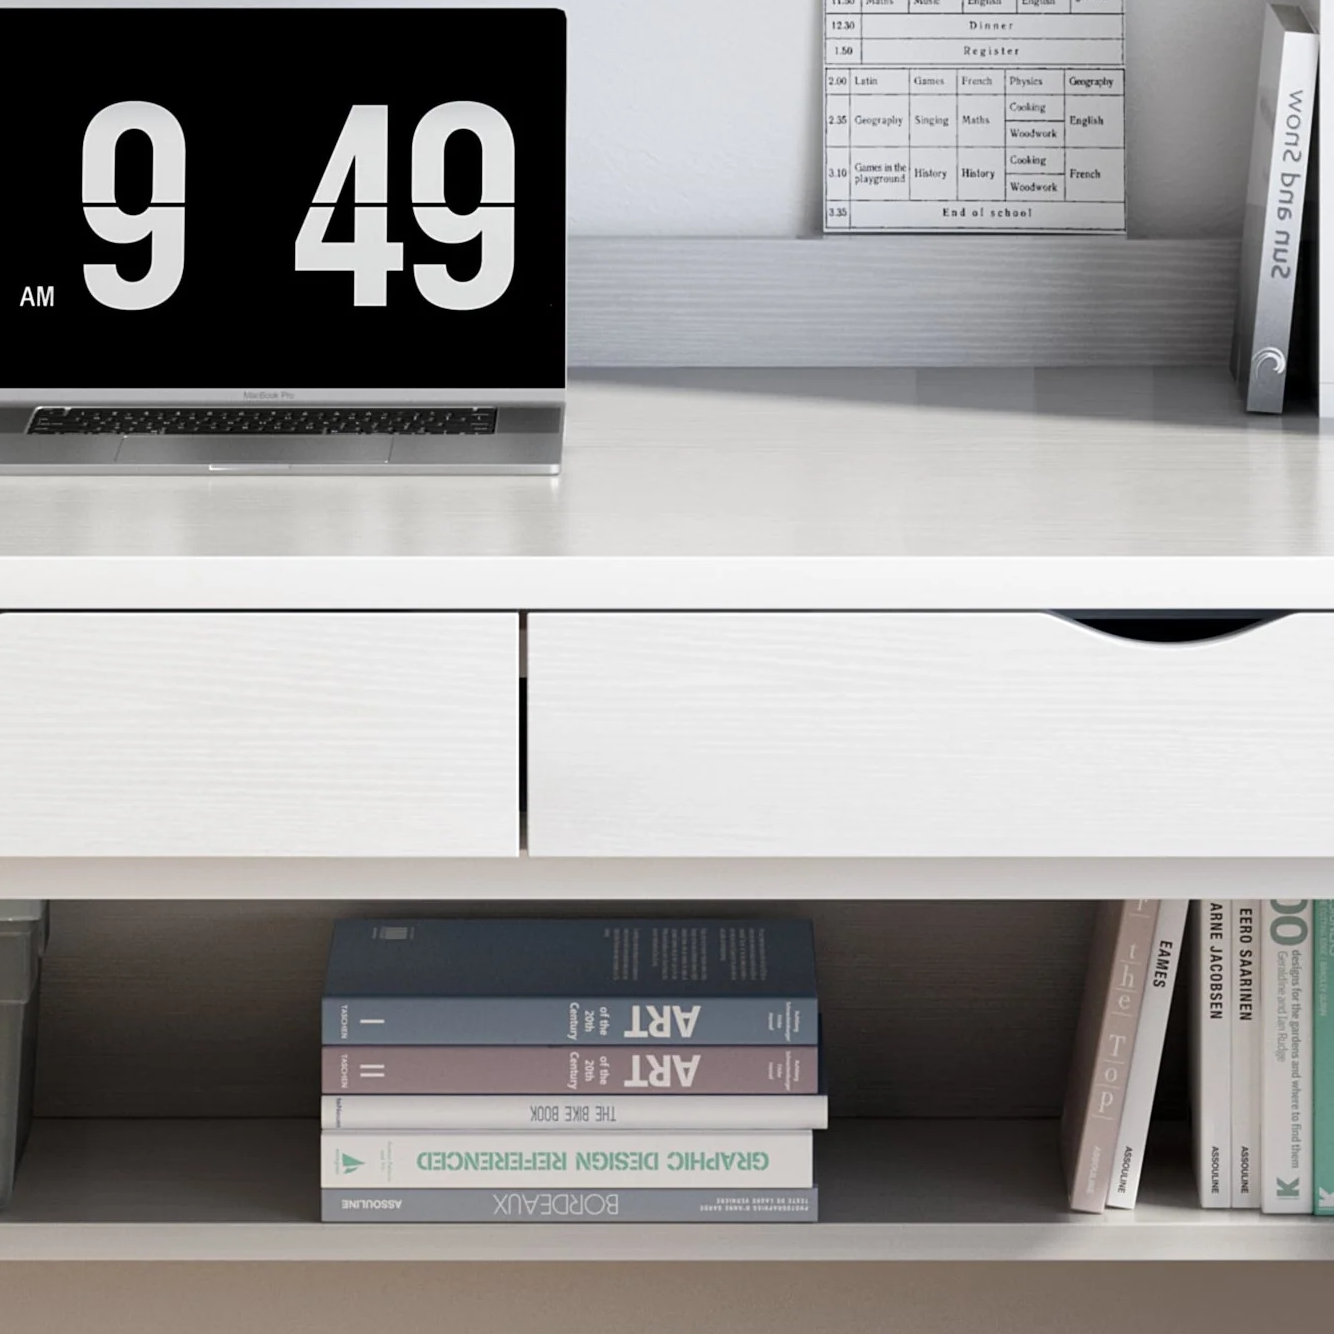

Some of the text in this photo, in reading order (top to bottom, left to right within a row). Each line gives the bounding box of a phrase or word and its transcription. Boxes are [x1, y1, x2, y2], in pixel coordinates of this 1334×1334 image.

[969, 21, 1014, 30] Dinner
[964, 46, 1019, 57] Register
[854, 76, 878, 85] Latin
[962, 76, 992, 85] French
[1009, 76, 1043, 87] Physics
[1069, 77, 1114, 88] Geography
[1009, 102, 1046, 113] Cooking
[854, 115, 903, 126] Geography
[915, 115, 949, 126] Singing
[1069, 116, 1104, 126] English
[1010, 129, 1058, 138] Woodwork
[82, 101, 515, 310] 9 49
[942, 208, 1033, 217] End of school
[20, 286, 54, 306] AM
[1153, 941, 1172, 987] EAMES
[1210, 903, 1222, 1018] ARNE JACOBSEN
[1240, 909, 1252, 1020] EERO SAARINEN
[624, 1006, 701, 1038] ART
[624, 1055, 700, 1087] ART
[531, 1106, 616, 1122] THE BIKE BOOK
[417, 1152, 769, 1172] GRAPHIC DESIGN REFERENCED
[342, 1194, 618, 1215] BORDEAUX ASSOULINE
